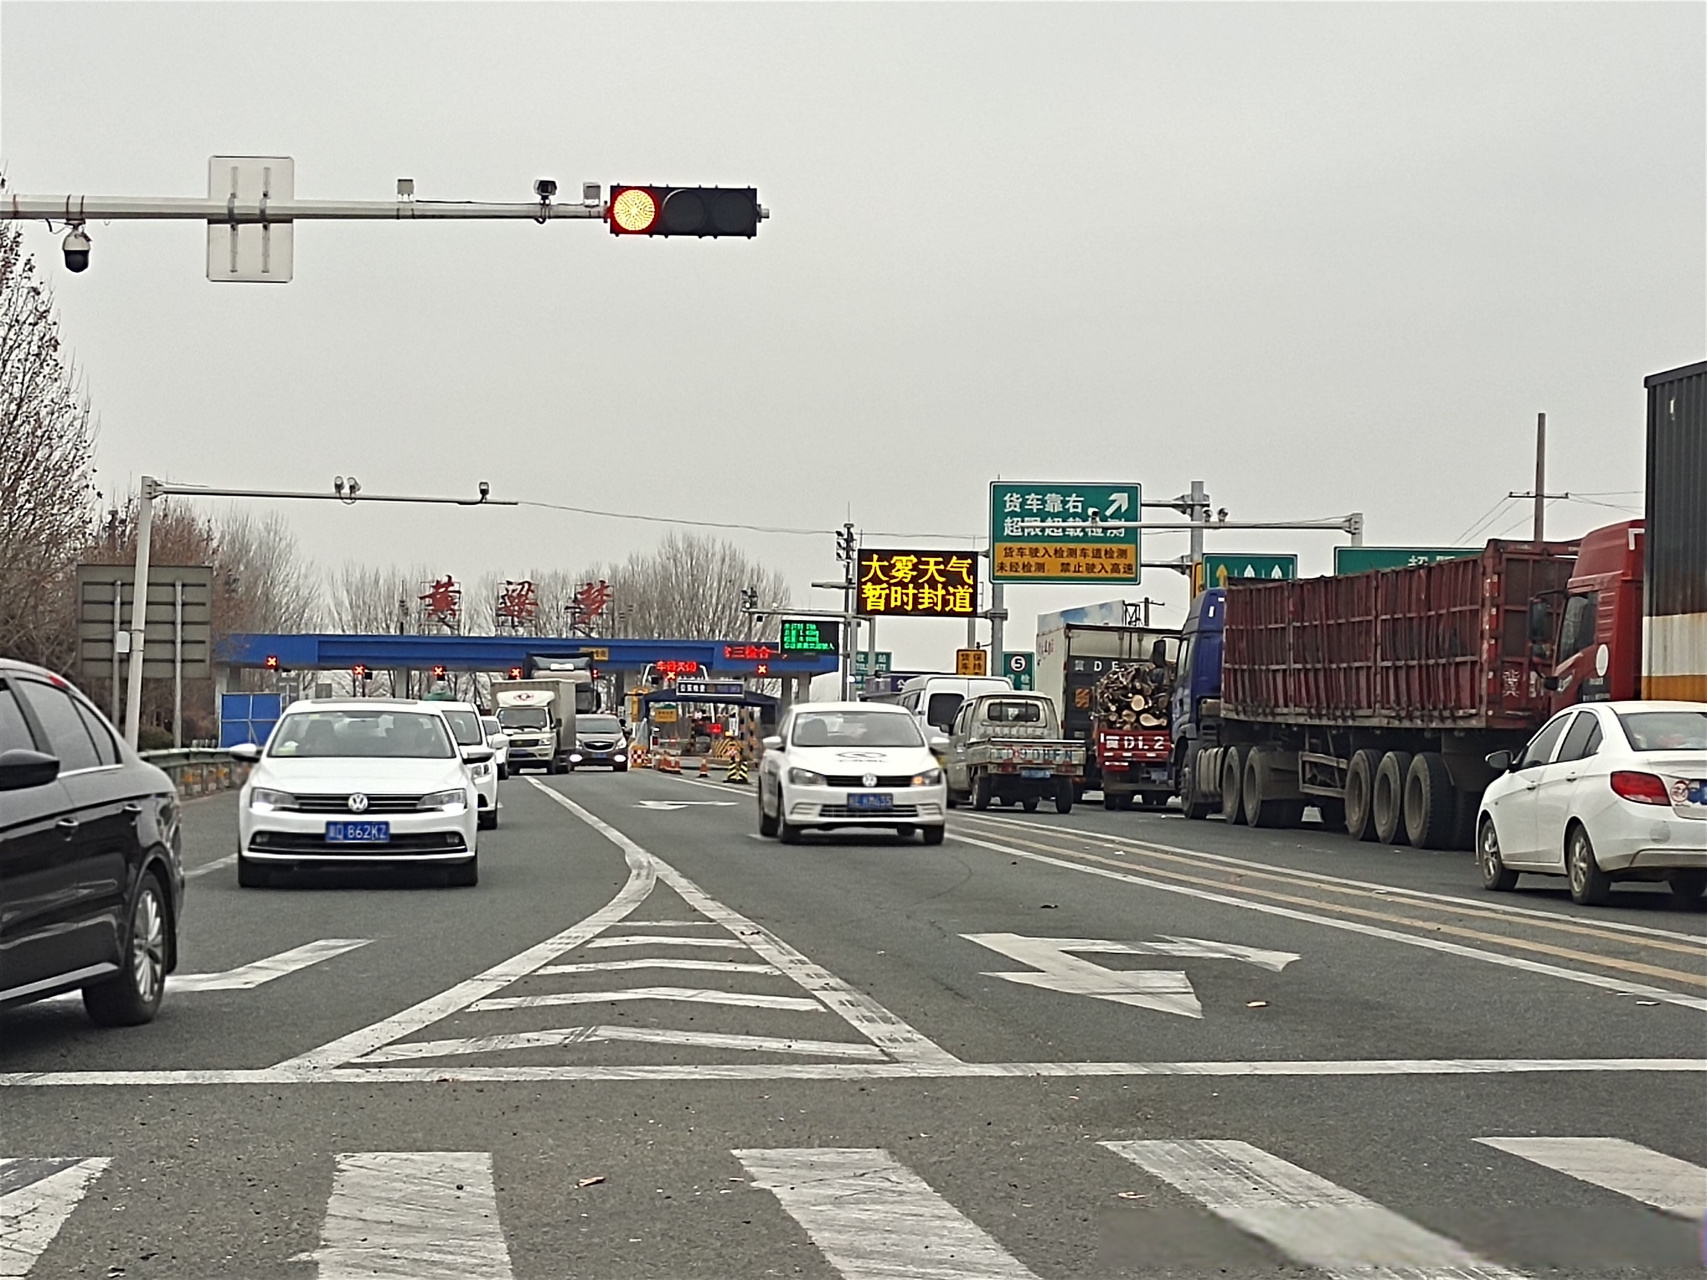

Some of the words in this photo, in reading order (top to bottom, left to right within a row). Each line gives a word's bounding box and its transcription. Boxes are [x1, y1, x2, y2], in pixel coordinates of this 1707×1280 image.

[1003, 493, 1084, 513] 货车靠右
[861, 553, 974, 584] 大雾天气
[861, 582, 974, 612] 暂时封道
[1014, 657, 1024, 670] 5
